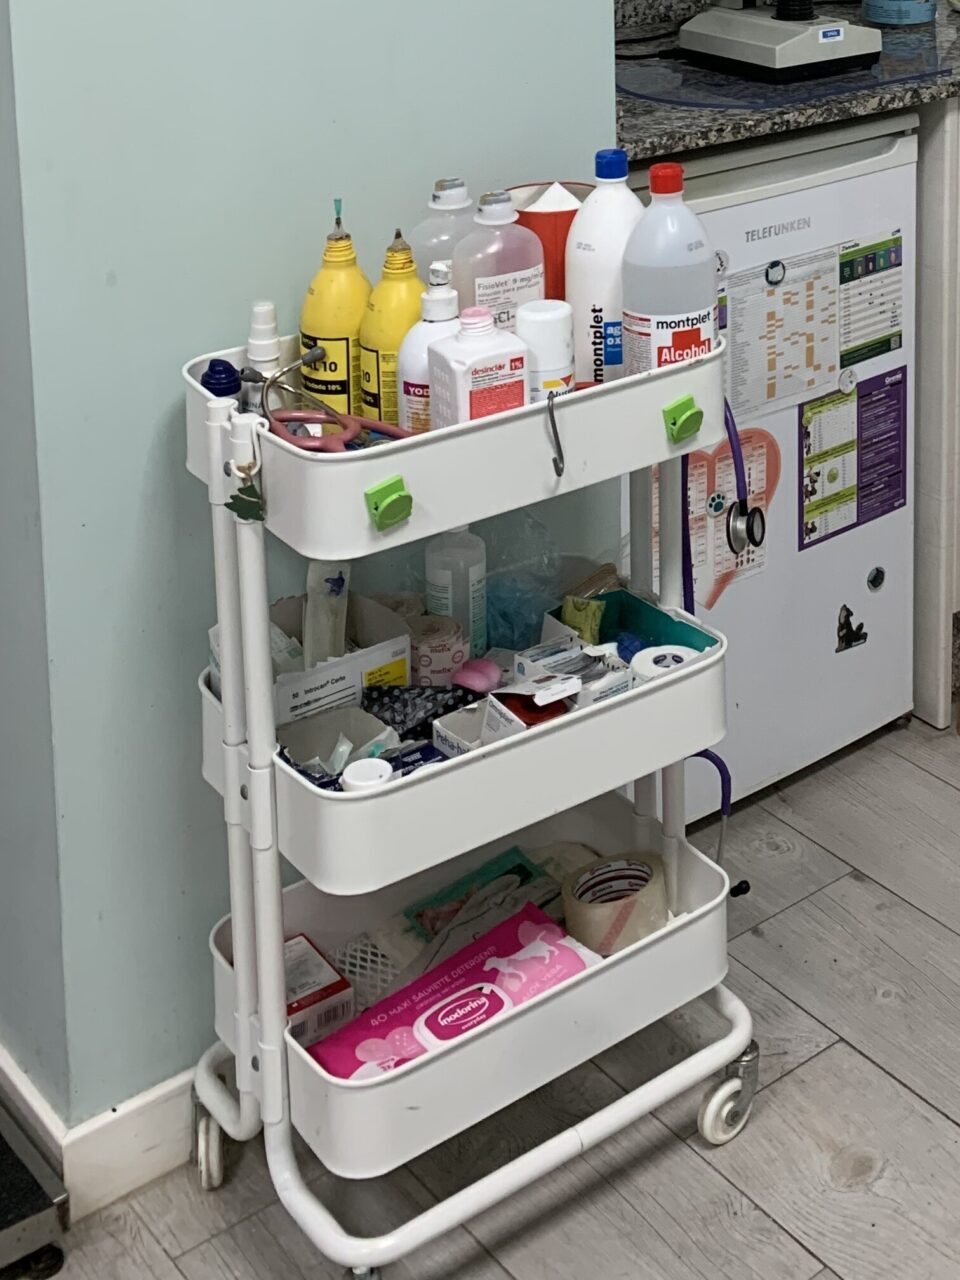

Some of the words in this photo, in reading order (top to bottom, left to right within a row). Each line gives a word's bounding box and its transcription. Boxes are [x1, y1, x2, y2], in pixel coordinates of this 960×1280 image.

[745, 216, 811, 243] TELEFUNKEN
[656, 311, 711, 330] montplet
[590, 306, 604, 383] montplet
[661, 342, 709, 362] Alcohol
[322, 361, 338, 372] 10
[371, 1014, 388, 1026] 40
